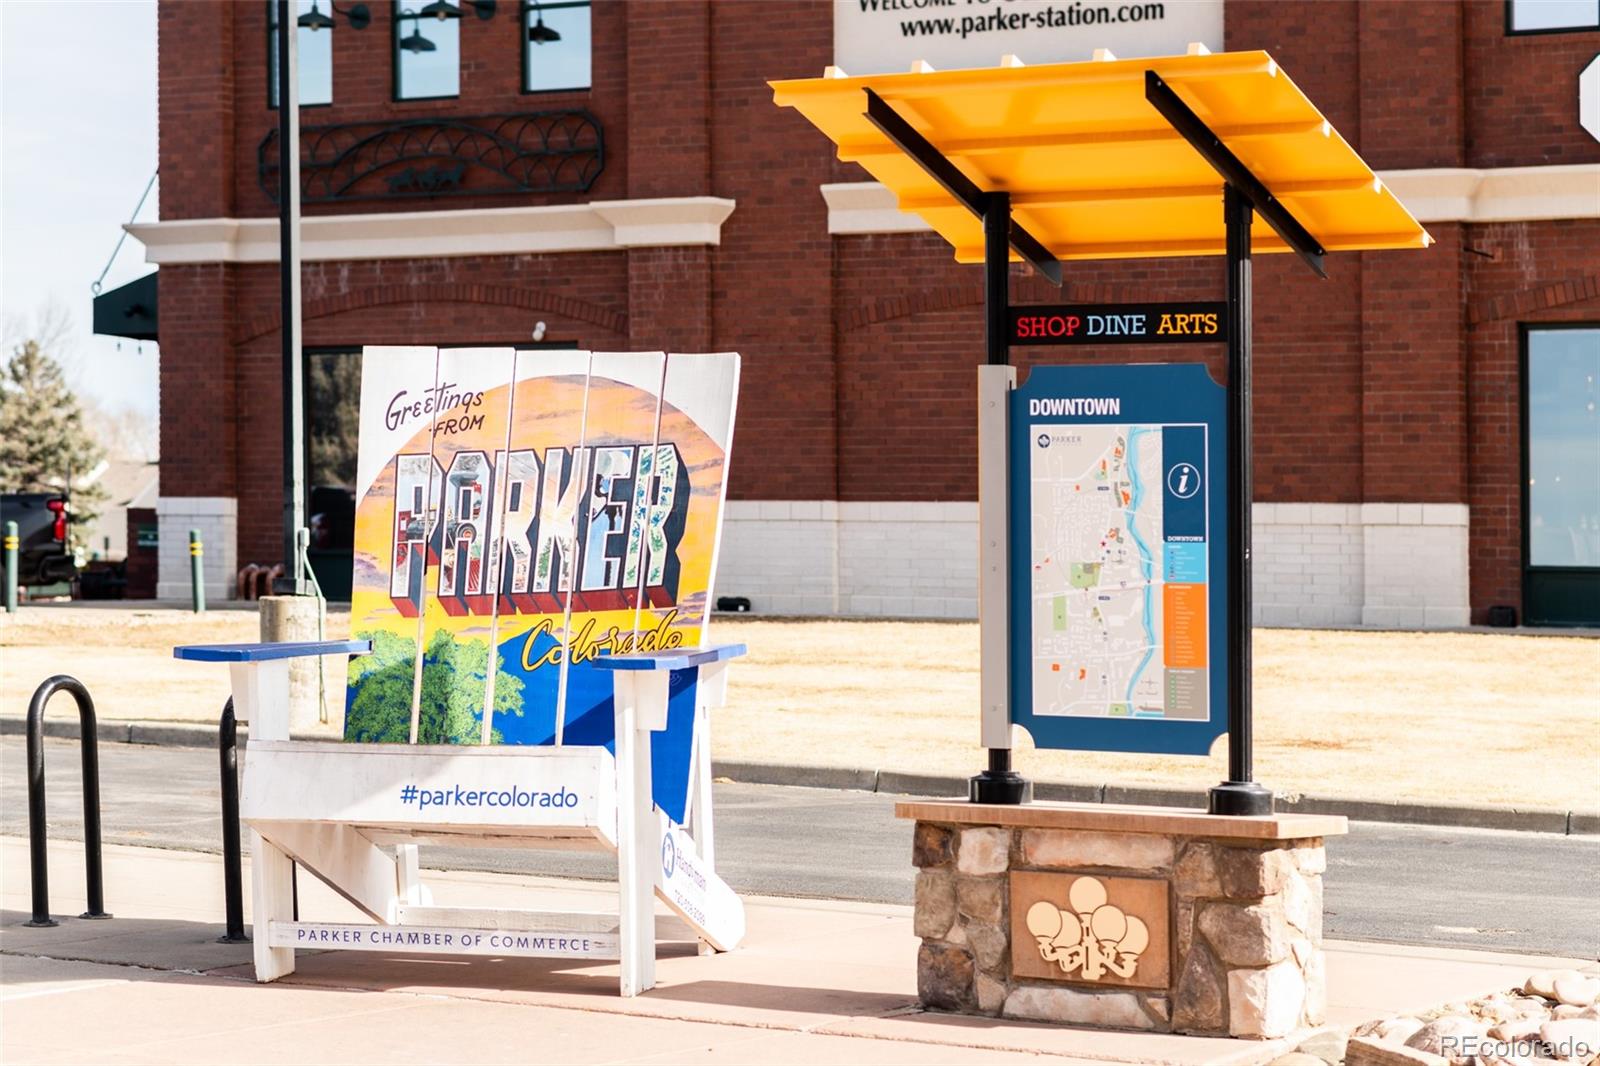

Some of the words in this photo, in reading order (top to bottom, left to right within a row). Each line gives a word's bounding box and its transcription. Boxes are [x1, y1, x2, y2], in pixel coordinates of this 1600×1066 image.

[902, 2, 1165, 38] www.parker-station.com
[1017, 316, 1080, 337] SHOP
[1087, 315, 1146, 335] DINE
[1156, 313, 1218, 334] ARTS
[386, 382, 485, 431] Greetings
[1030, 398, 1120, 416] DOWNTOWN
[432, 415, 485, 438] FROM
[390, 443, 691, 618] PARKER
[521, 609, 683, 672] Colorado
[400, 784, 579, 809] #parkercolorado
[297, 929, 361, 943] PARKER
[370, 932, 453, 946] CHAMBER
[461, 936, 482, 946] OF
[490, 937, 590, 951] COMMERCE
